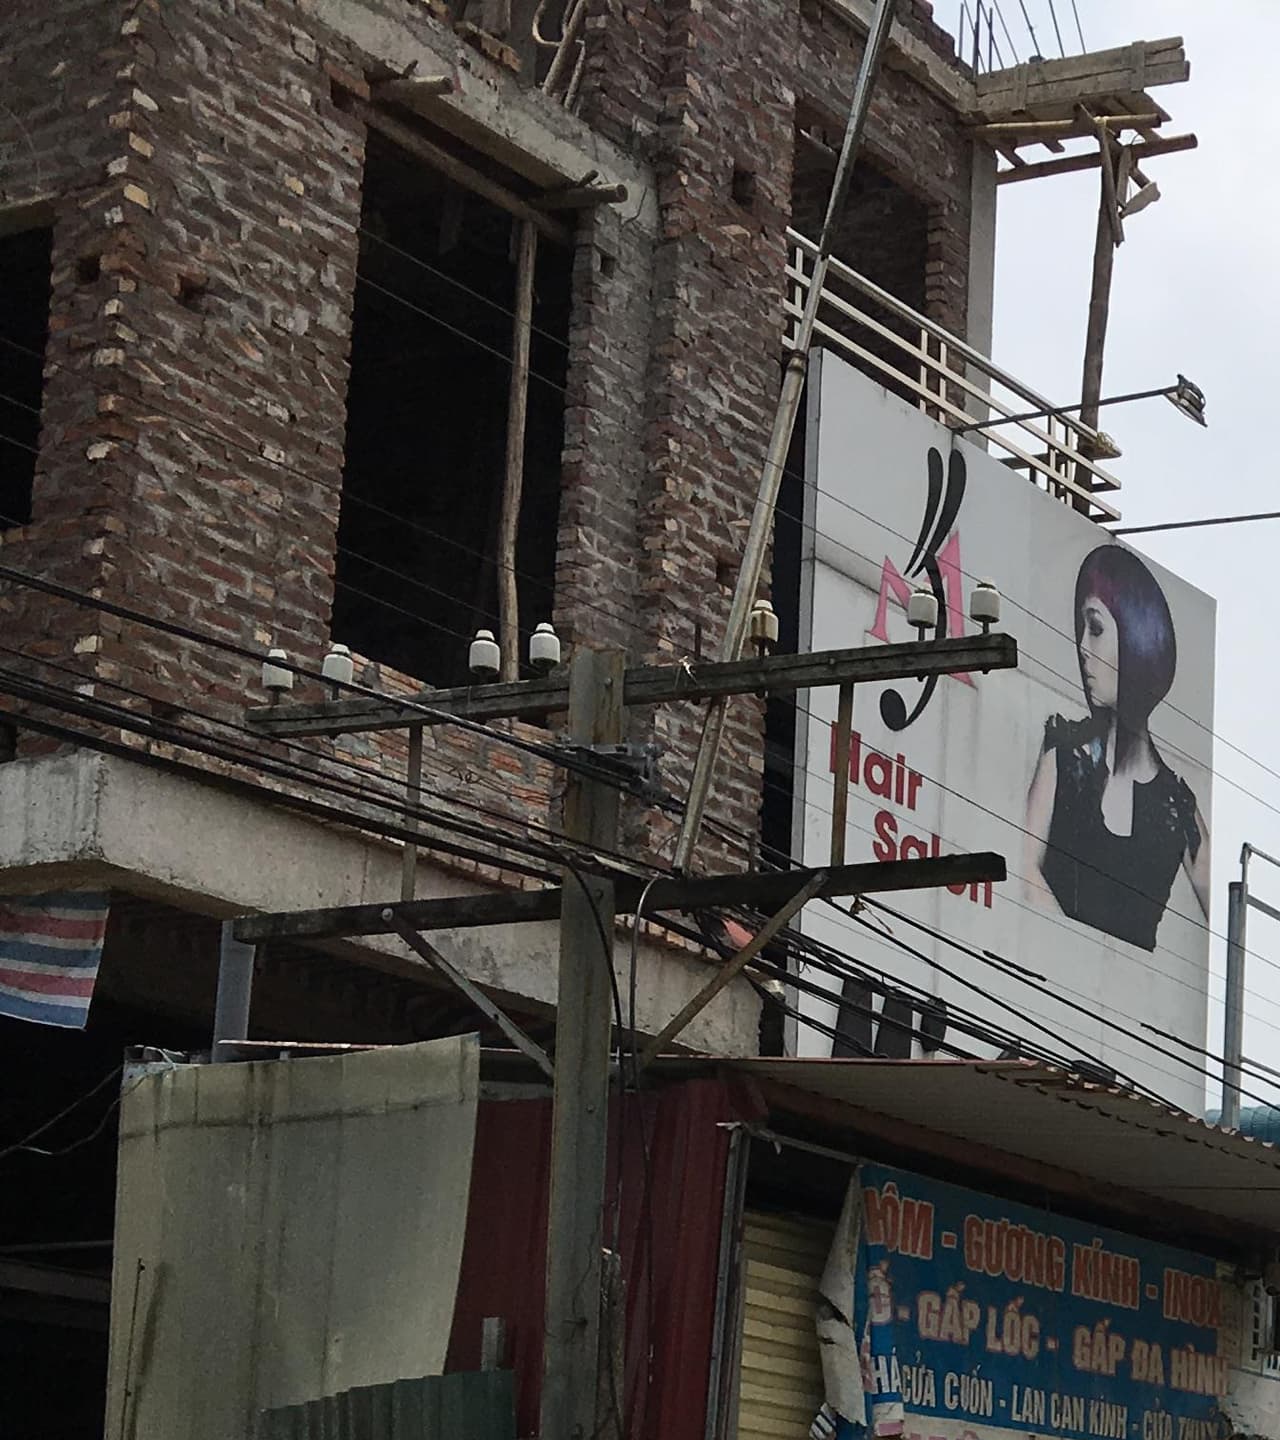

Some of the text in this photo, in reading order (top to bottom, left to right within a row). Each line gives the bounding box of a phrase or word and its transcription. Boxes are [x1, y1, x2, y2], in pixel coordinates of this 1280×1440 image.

[830, 721, 923, 811] Hair
[964, 1215, 1065, 1292] GƯƠNG
[1072, 1238, 1140, 1310] KÍNH
[1163, 1268, 1225, 1329] INOX
[916, 1280, 981, 1346] GẤP
[985, 1296, 1041, 1361] LỐC
[1073, 1317, 1126, 1377] GẤP
[1131, 1338, 1165, 1386] ĐA
[1170, 1342, 1231, 1397] HÌNH
[901, 1350, 937, 1409] CỬA
[943, 1364, 994, 1418] CUỐN
[1011, 1384, 1046, 1428] LAN
[1050, 1391, 1086, 1435] CAN
[1088, 1394, 1128, 1440] KÍNH
